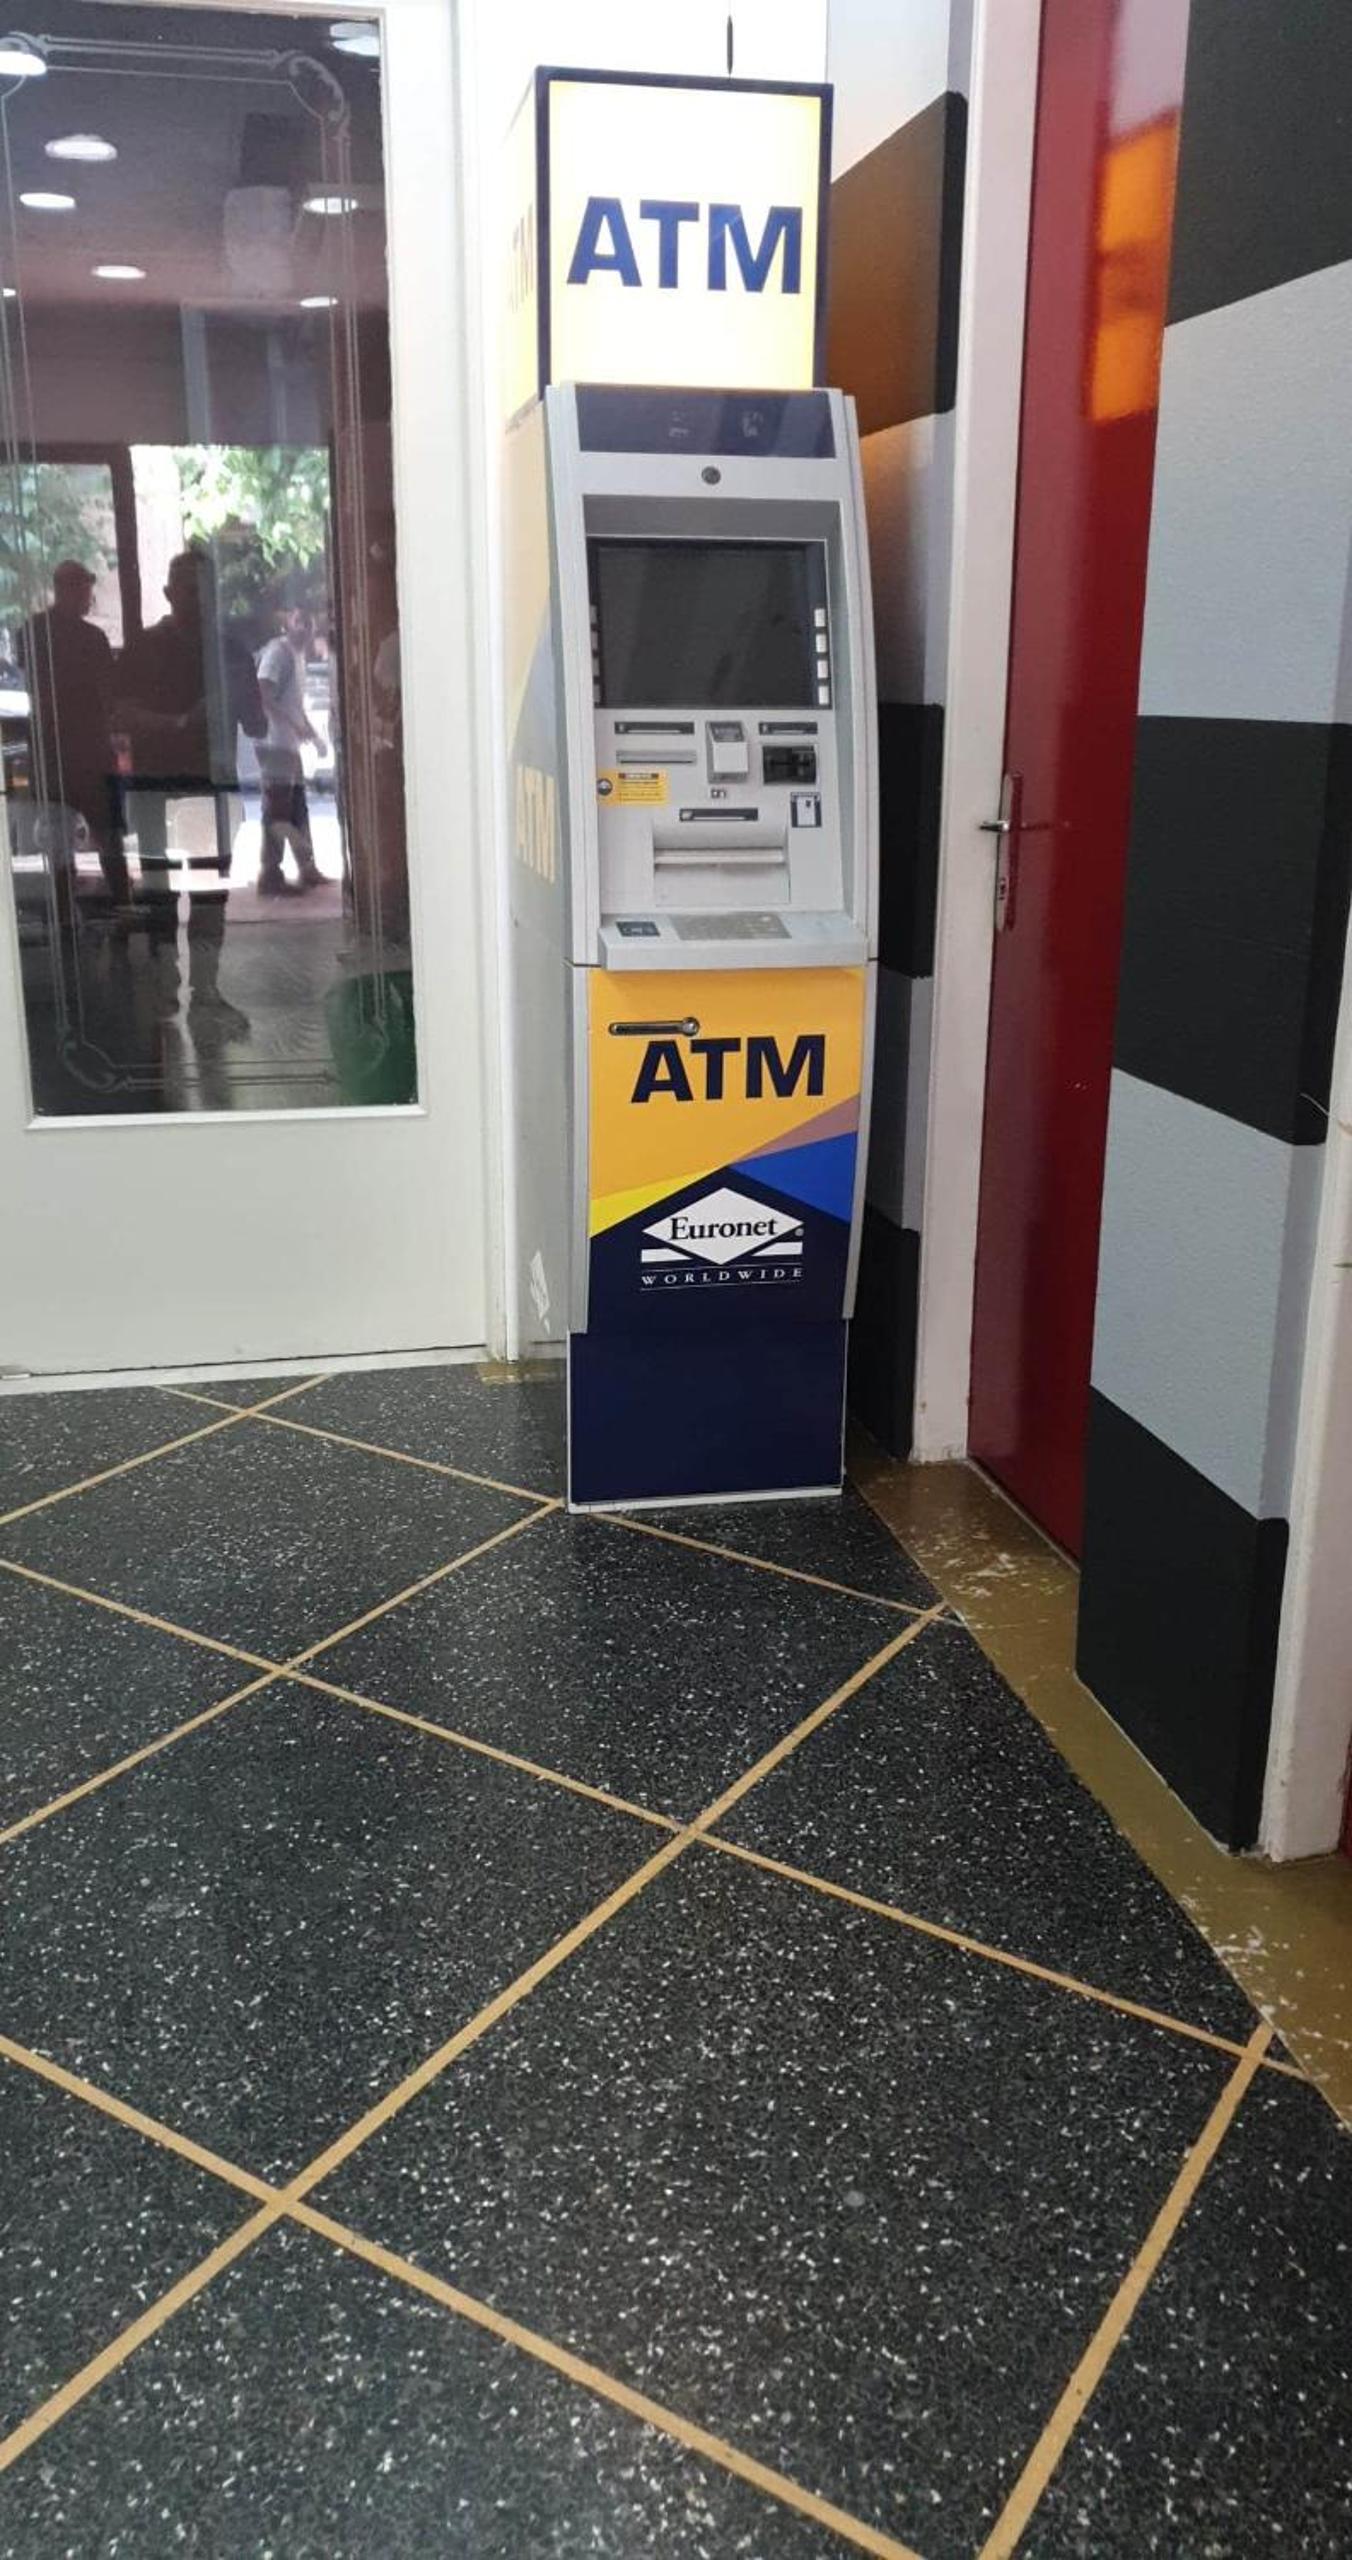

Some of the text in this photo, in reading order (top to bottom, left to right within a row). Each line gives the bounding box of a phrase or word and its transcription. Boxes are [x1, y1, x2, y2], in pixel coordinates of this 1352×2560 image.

[566, 196, 804, 295] ATM
[515, 765, 556, 884] ATM
[631, 1034, 826, 1104] ATM
[669, 1216, 778, 1241] Euronet
[641, 1267, 803, 1286] WORLDWIDE
